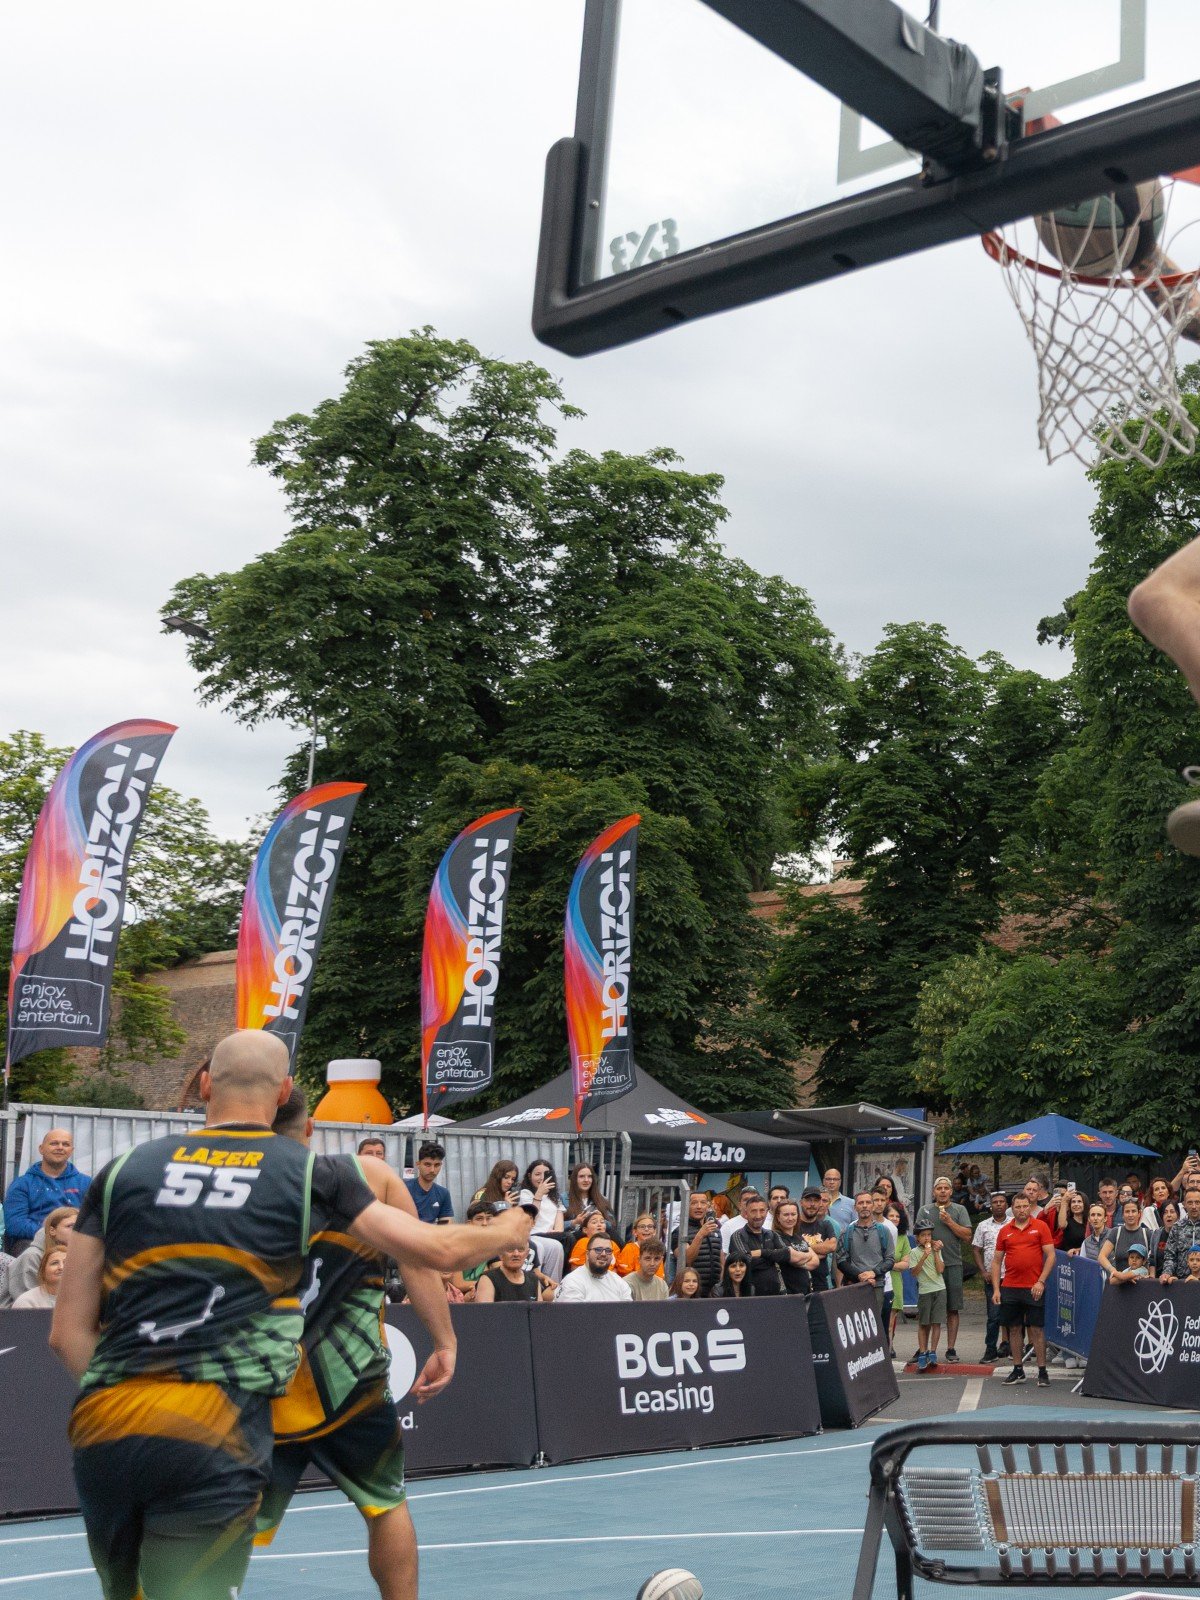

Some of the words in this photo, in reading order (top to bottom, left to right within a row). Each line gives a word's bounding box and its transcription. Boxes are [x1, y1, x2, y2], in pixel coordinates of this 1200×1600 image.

[65, 743, 156, 966] HORIZON
[263, 810, 345, 1019] HORIZON
[462, 838, 509, 1027] HORIZON
[600, 850, 631, 1038] HORIZON
[21, 982, 66, 999] enjoy.
[20, 996, 73, 1010] evolve.
[18, 1011, 93, 1025] entertain.
[436, 1046, 468, 1061] enjoy.
[436, 1056, 472, 1069] evolve.
[435, 1066, 486, 1080] entertain.
[172, 1146, 265, 1168] LAZER
[683, 1140, 746, 1163] 3la3.ro
[156, 1161, 262, 1208] 55
[615, 1331, 703, 1379] BCR
[1179, 1350, 1189, 1362] de
[620, 1381, 715, 1414] Leasing
